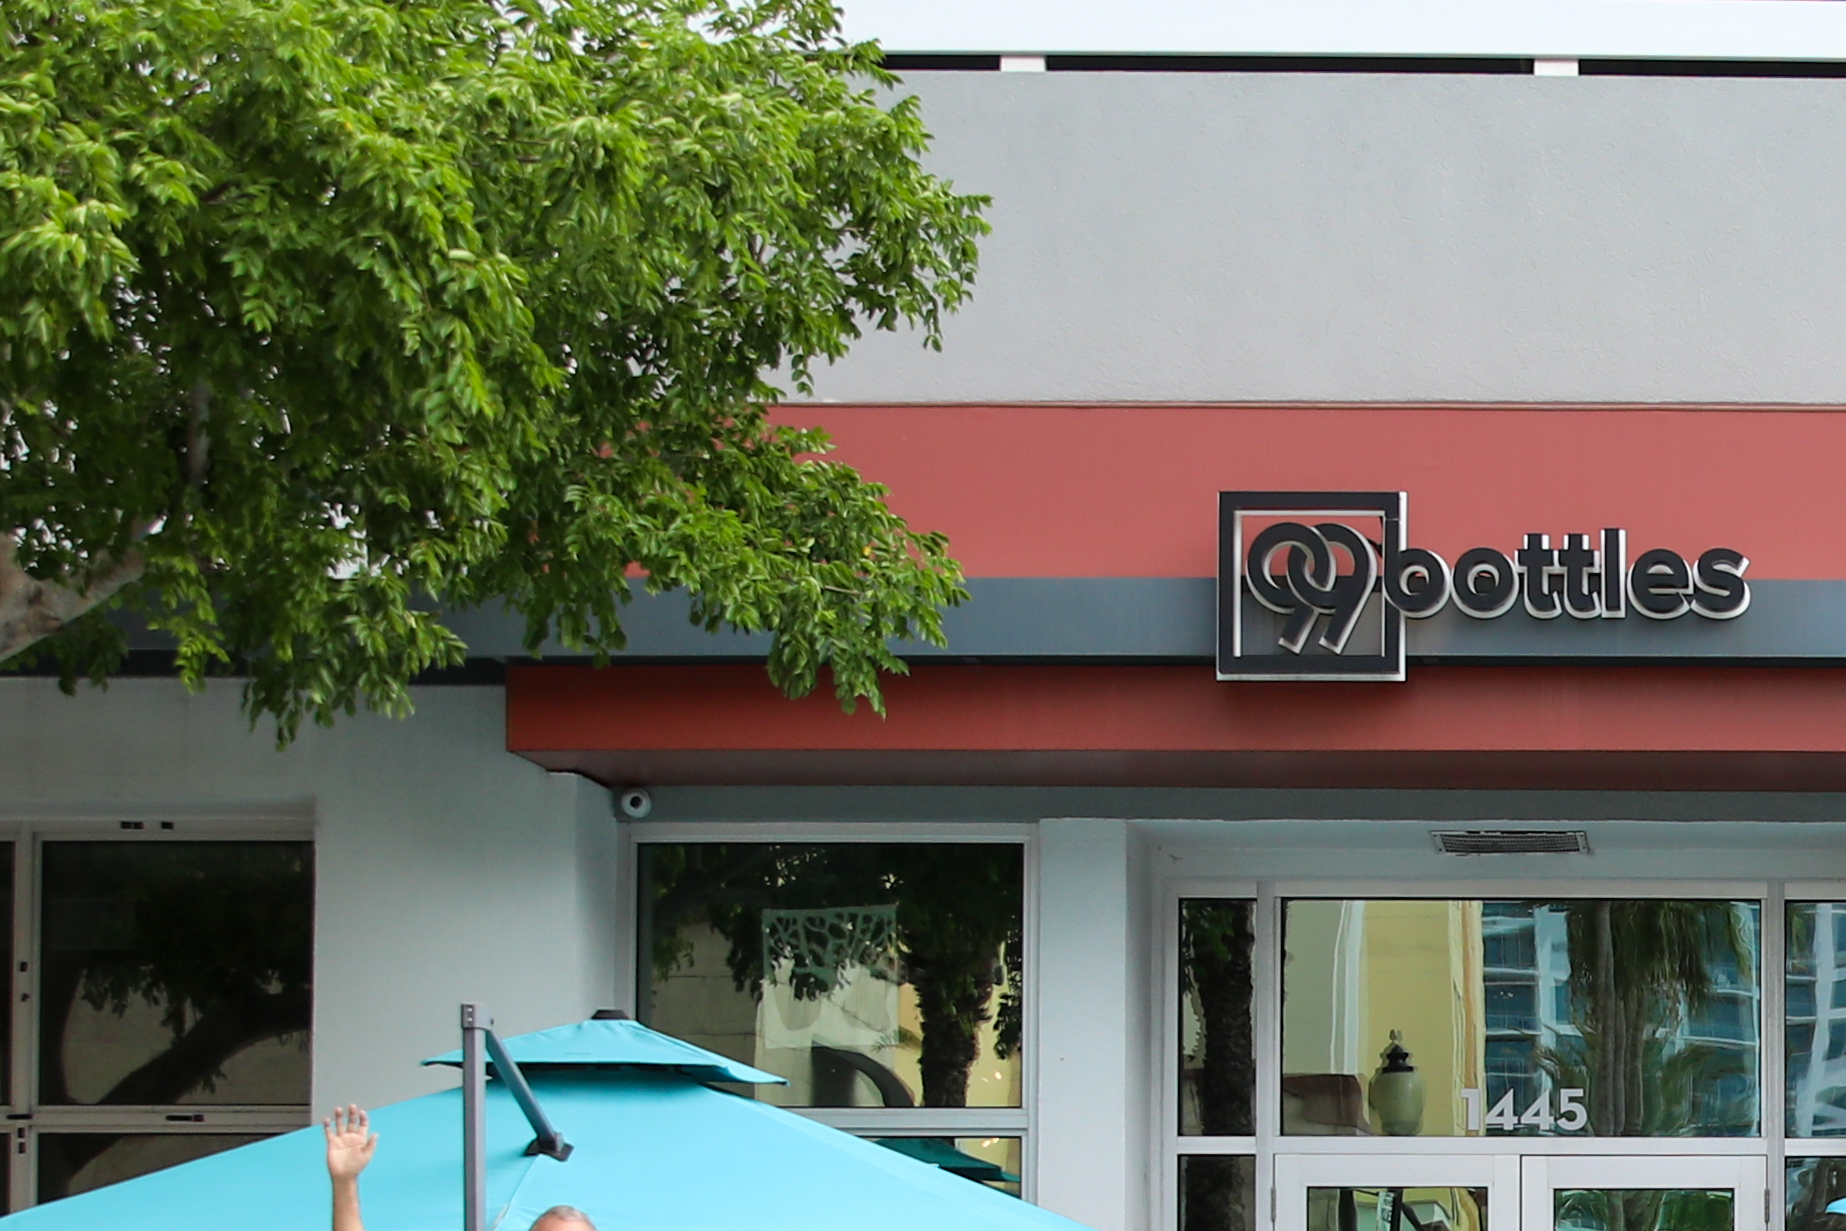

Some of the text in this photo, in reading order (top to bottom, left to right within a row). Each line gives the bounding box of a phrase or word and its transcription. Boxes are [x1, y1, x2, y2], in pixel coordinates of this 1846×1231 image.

[1246, 519, 1752, 655] 99 bottles
[1461, 1087, 1588, 1131] 1445
